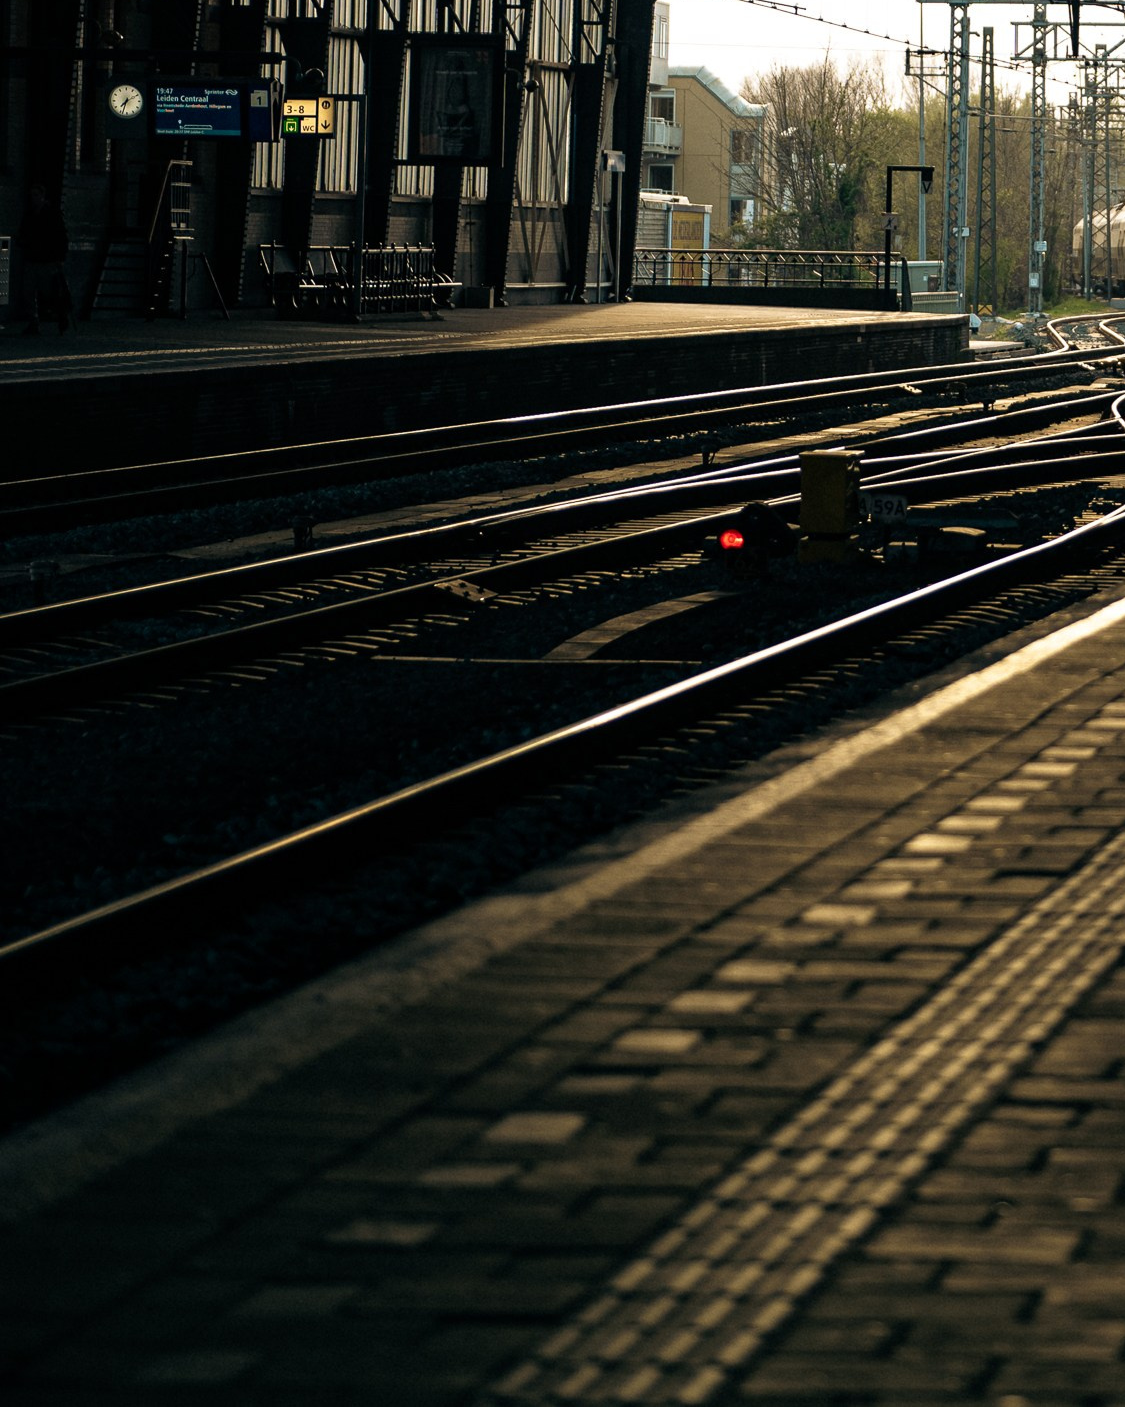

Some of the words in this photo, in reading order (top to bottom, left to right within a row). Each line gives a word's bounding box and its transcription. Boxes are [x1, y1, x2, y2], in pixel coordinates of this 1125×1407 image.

[156, 87, 174, 95] 19:47
[180, 95, 209, 103] Centraal
[256, 96, 262, 105] 1
[873, 497, 906, 516] 59A
